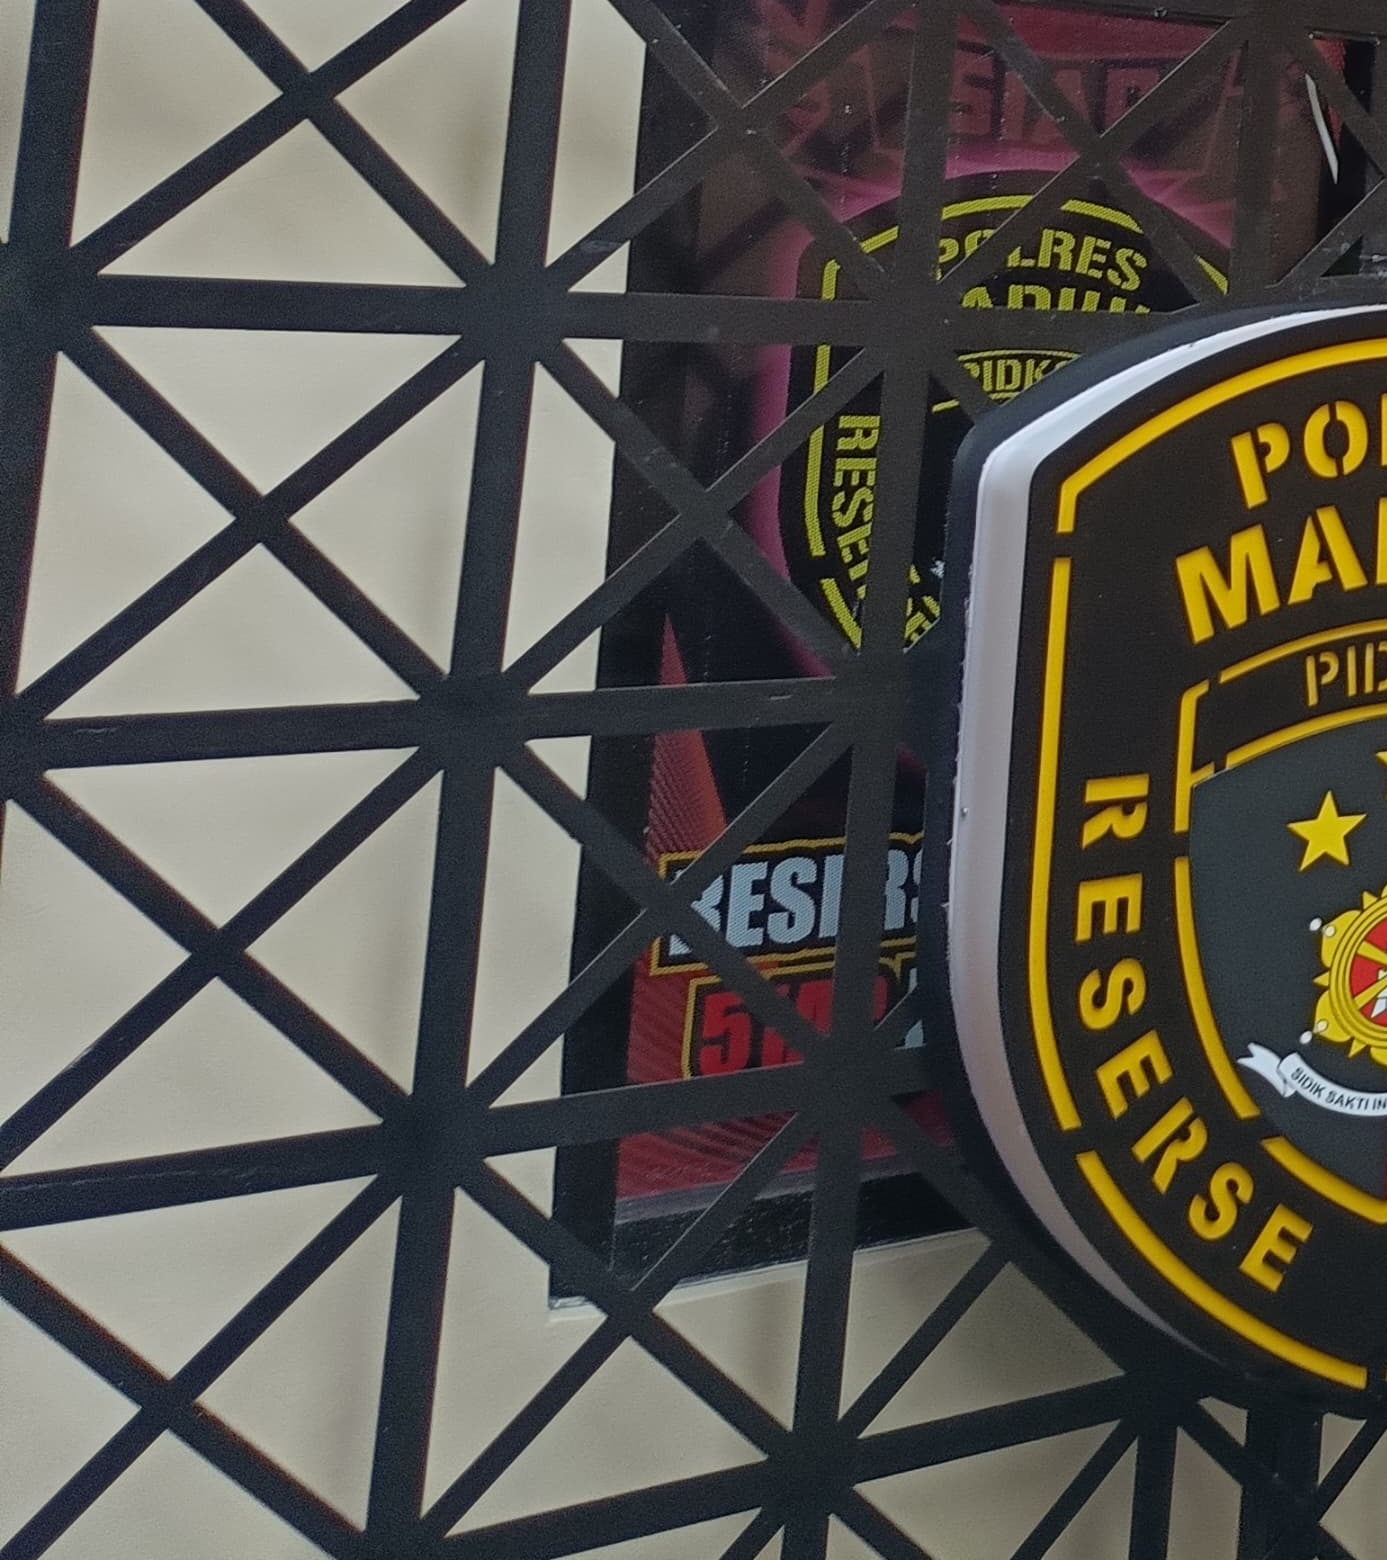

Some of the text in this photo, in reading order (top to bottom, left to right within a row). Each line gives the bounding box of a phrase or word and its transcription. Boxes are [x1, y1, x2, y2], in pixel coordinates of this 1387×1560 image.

[1075, 770, 1314, 1295] RESERSE
[1290, 1066, 1324, 1101] SIDIK
[1325, 1090, 1369, 1112] SAKTI
